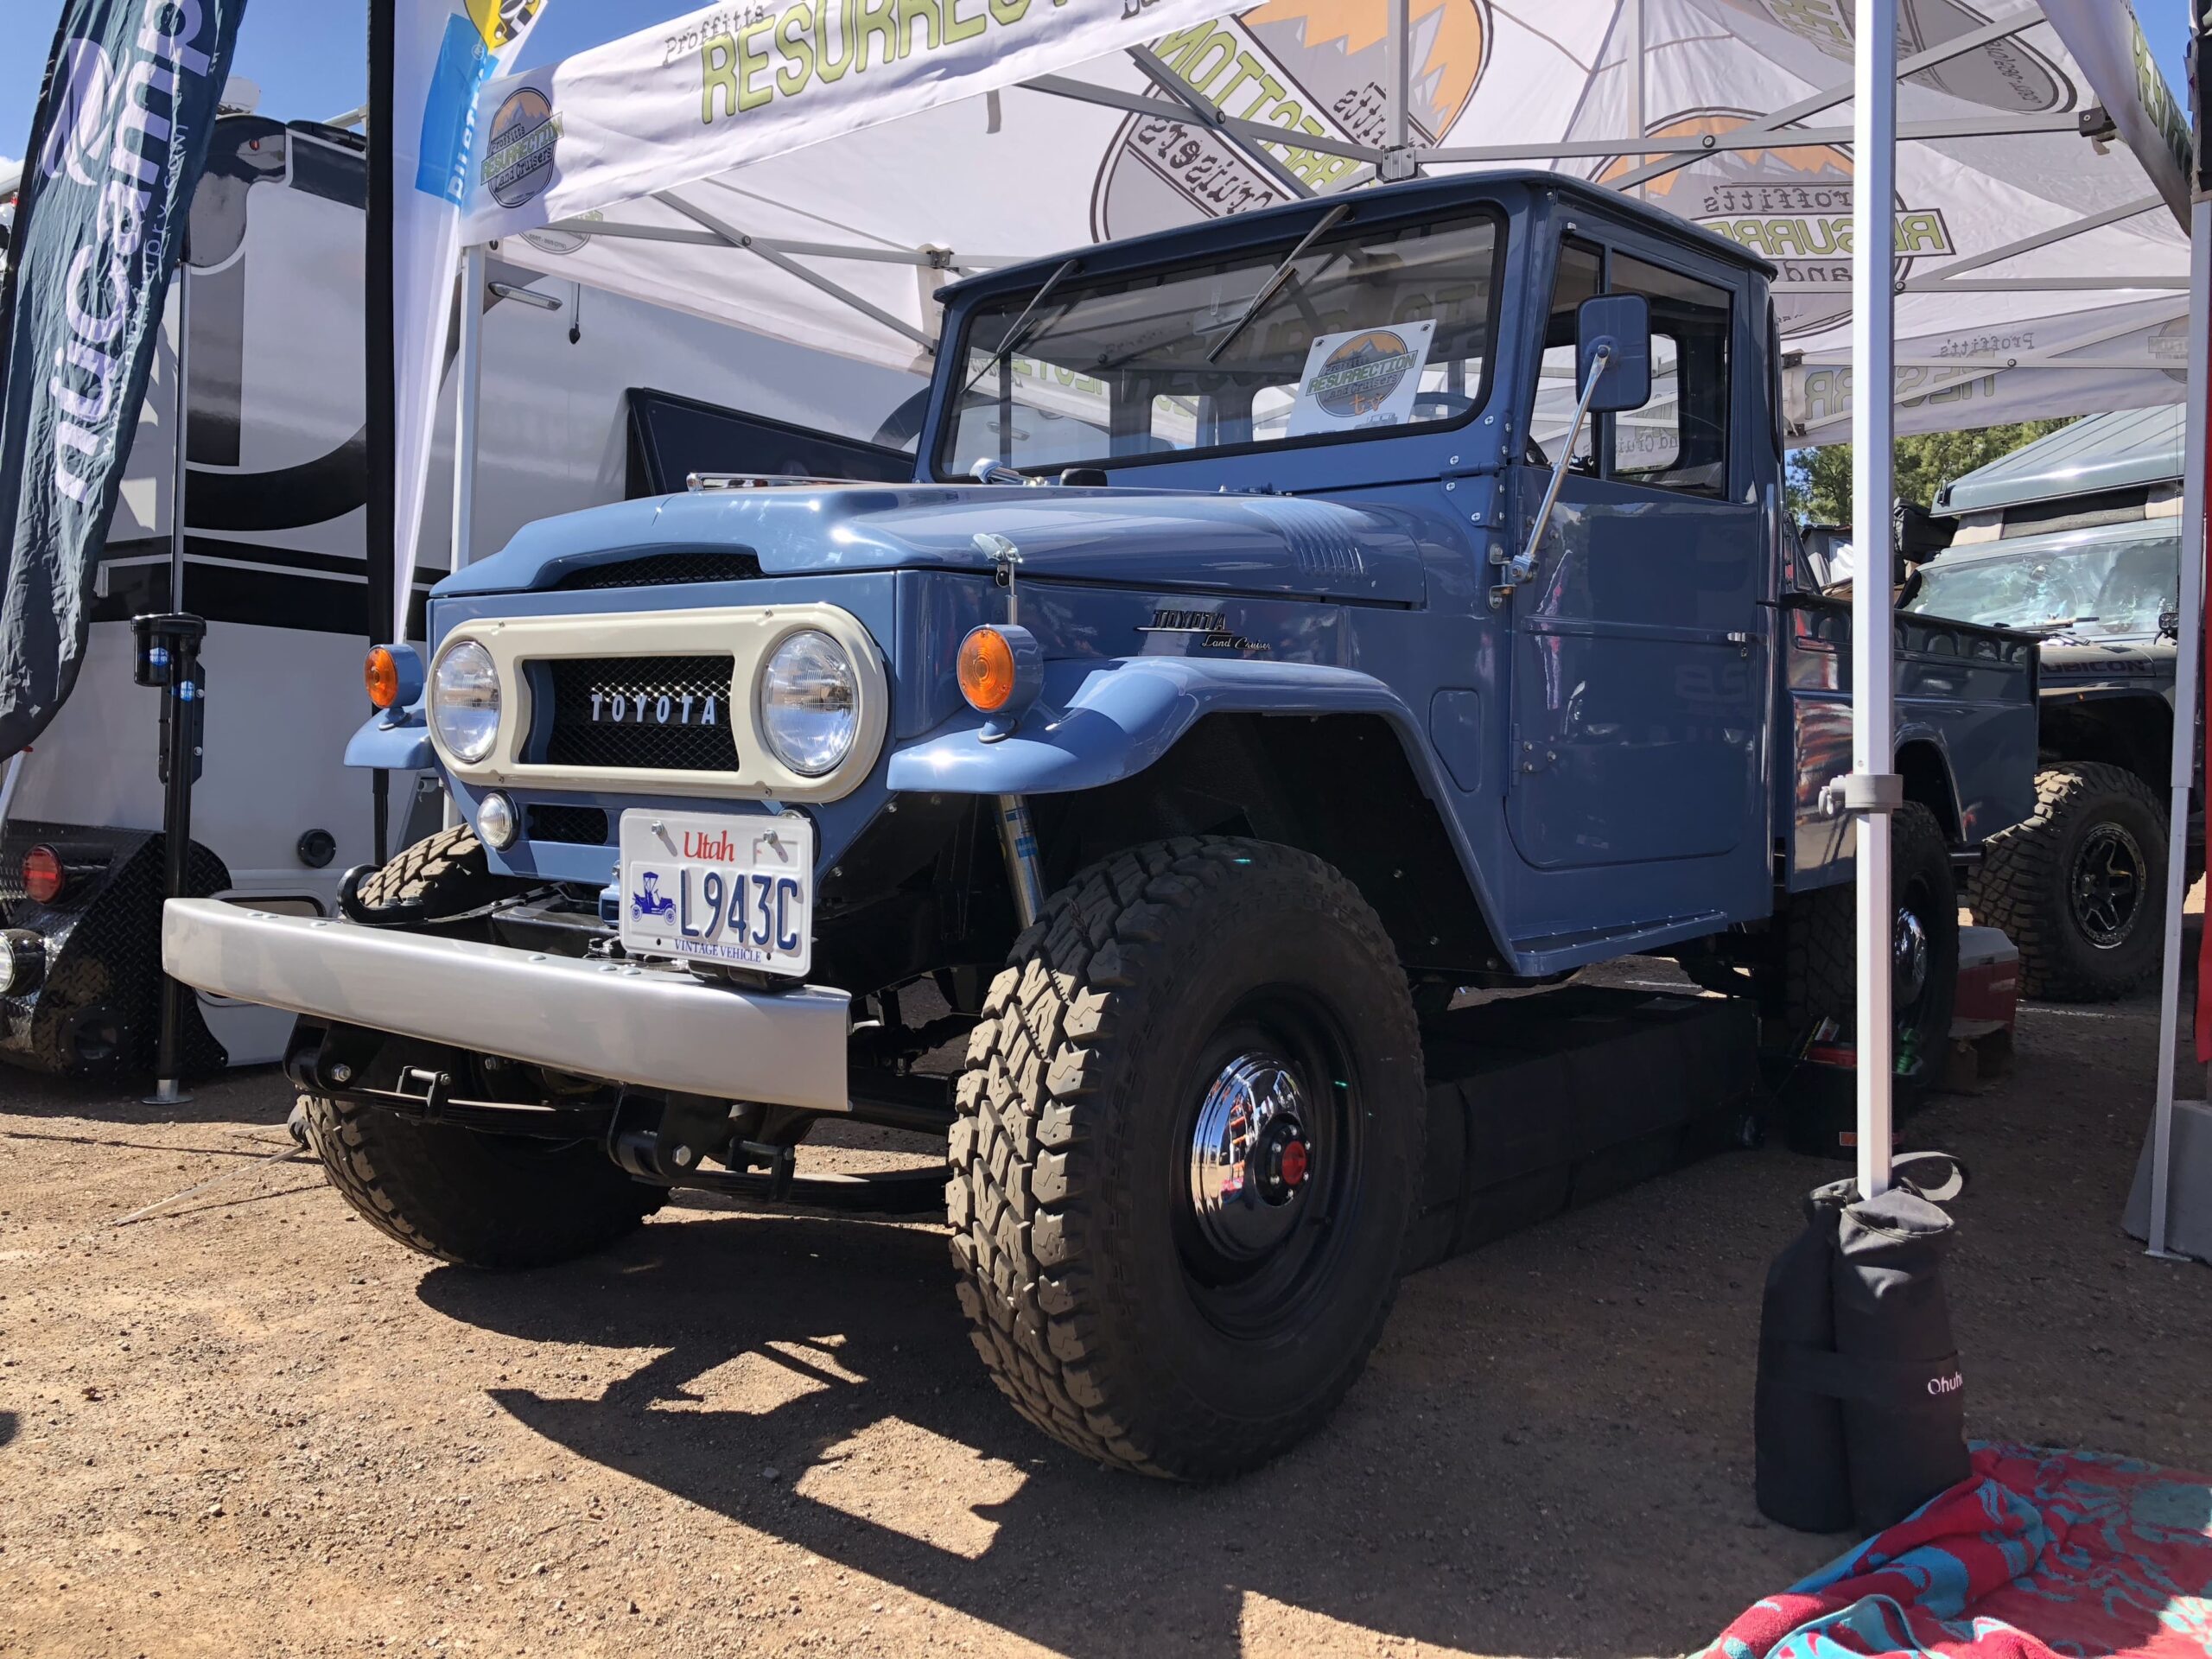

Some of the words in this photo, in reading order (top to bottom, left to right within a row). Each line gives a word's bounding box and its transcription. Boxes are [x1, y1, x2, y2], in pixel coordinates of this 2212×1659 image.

[1308, 353, 1416, 394] RESURRECTION
[1351, 373, 1398, 394] Cruisers
[1349, 391, 1384, 416] tv
[1154, 608, 1226, 631] TOYOTA
[1202, 634, 1232, 647] Land
[1234, 636, 1273, 651] Cruiser
[591, 694, 715, 725] TOYOTA
[683, 830, 735, 862] Utah
[680, 868, 798, 950] L943C
[674, 938, 719, 957] VINTAGE
[721, 945, 762, 963] VEHICLE
[1927, 1370, 1963, 1395] Ohuh
